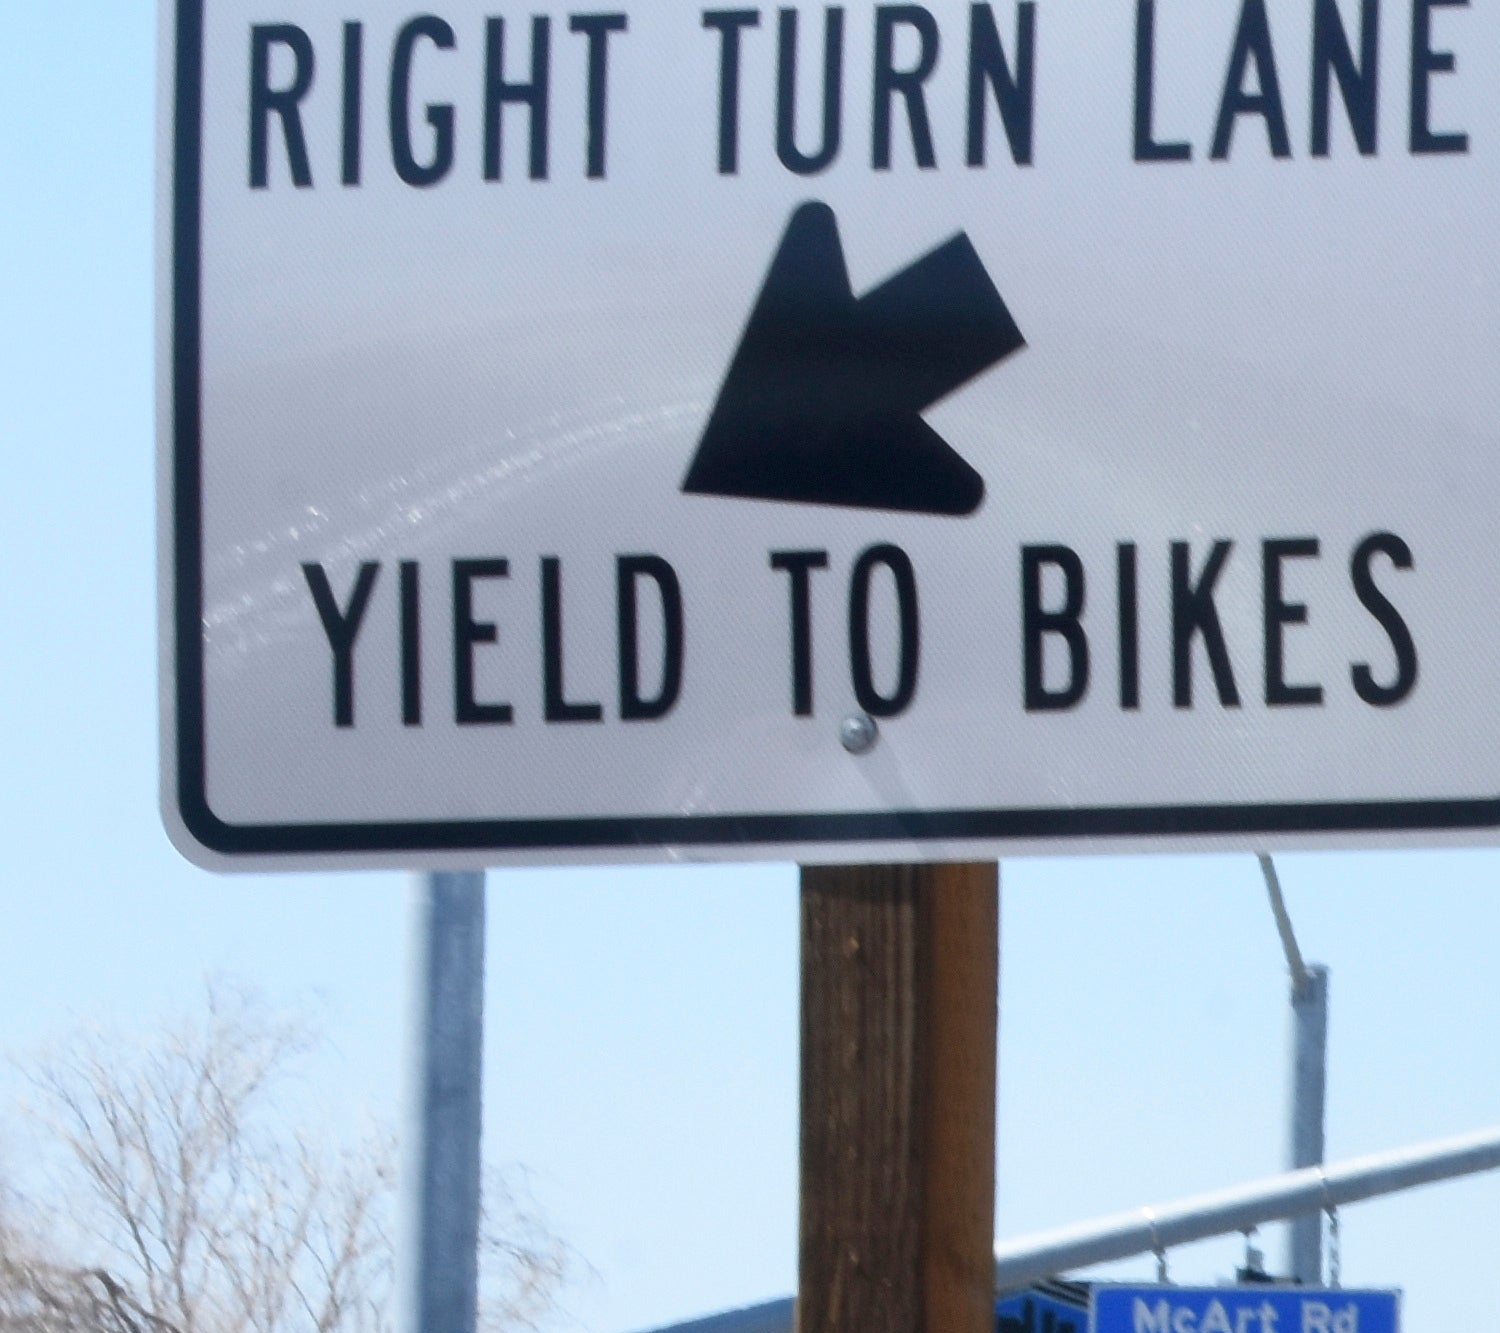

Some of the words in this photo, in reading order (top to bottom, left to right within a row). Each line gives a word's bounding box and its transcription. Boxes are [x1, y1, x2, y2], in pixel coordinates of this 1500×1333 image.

[246, 13, 631, 190] RIGHT
[714, 2, 1036, 177] TURN
[1131, 0, 1471, 164] LANE
[302, 551, 687, 731] YIELD
[770, 541, 921, 722] TO
[1018, 531, 1422, 715] BIKES
